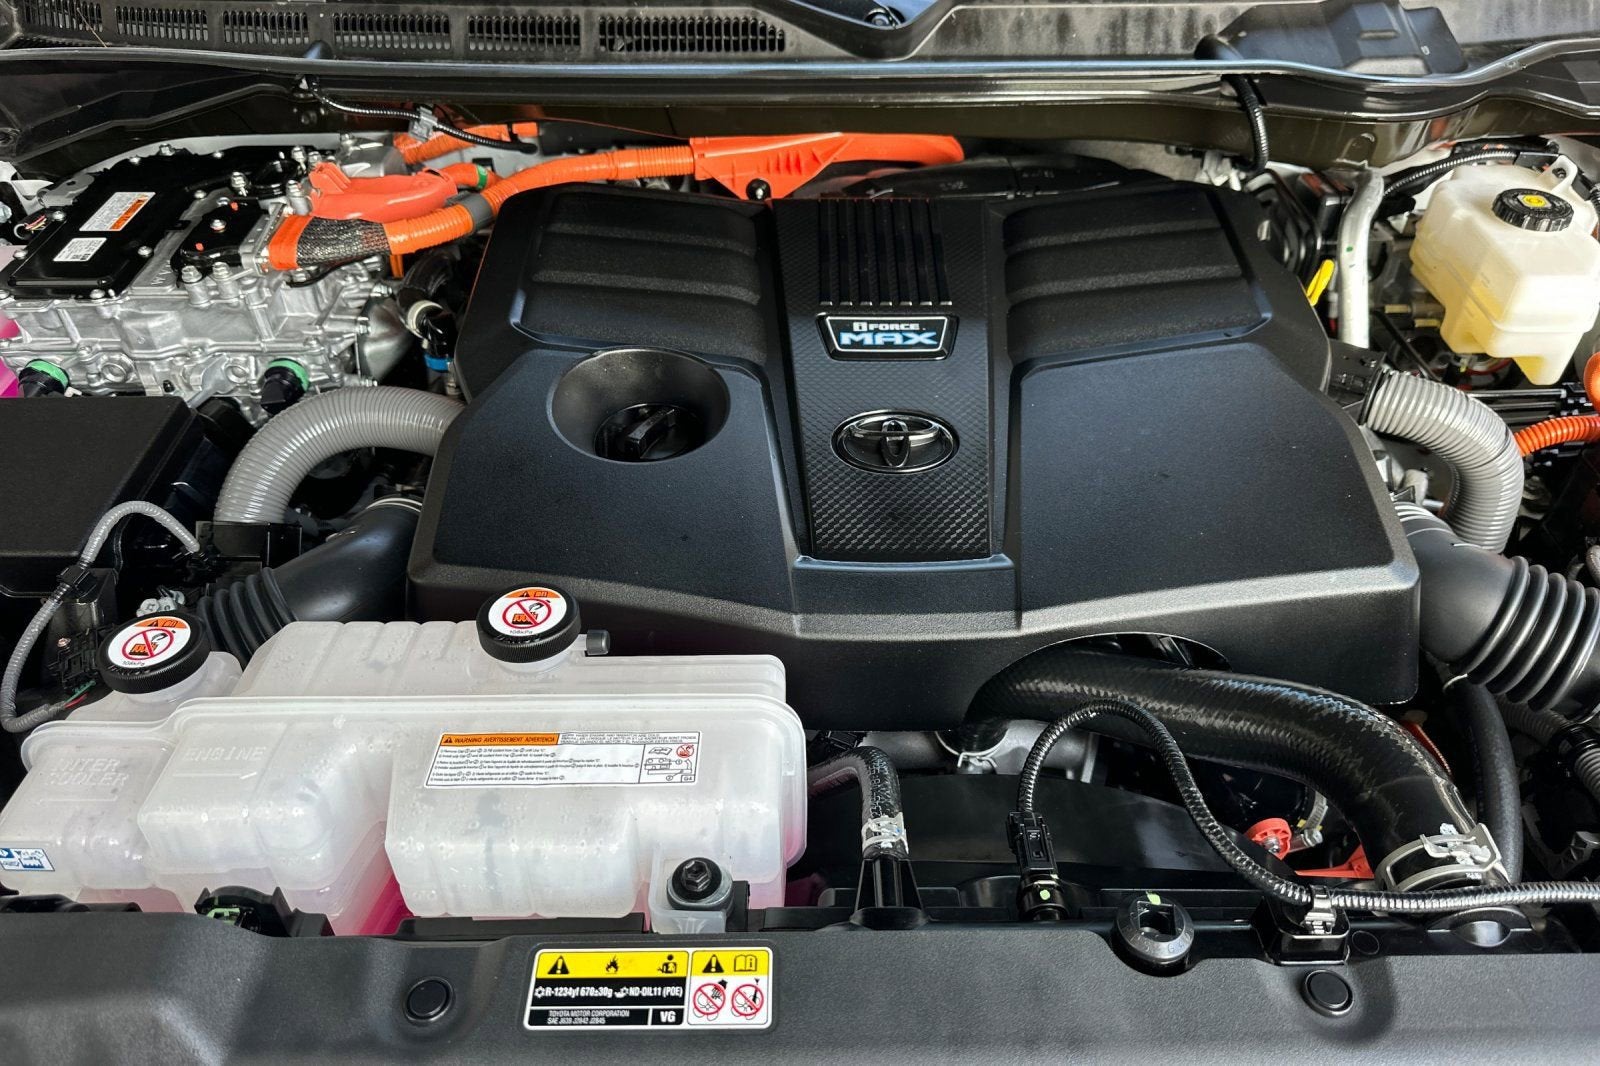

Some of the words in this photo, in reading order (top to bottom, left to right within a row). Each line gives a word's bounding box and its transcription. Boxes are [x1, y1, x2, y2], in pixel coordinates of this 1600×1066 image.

[840, 332, 938, 345] MAX
[182, 746, 267, 761] ENGINE
[545, 986, 579, 998] R-1234yf
[629, 986, 661, 997] ND-OIL11
[662, 986, 683, 998] (POE)
[549, 1010, 571, 1018] TOYOTA
[571, 1010, 590, 1018] MOTOR
[591, 1010, 630, 1018] CORPORATION
[659, 1011, 676, 1023] VG
[547, 1017, 558, 1025] SAE
